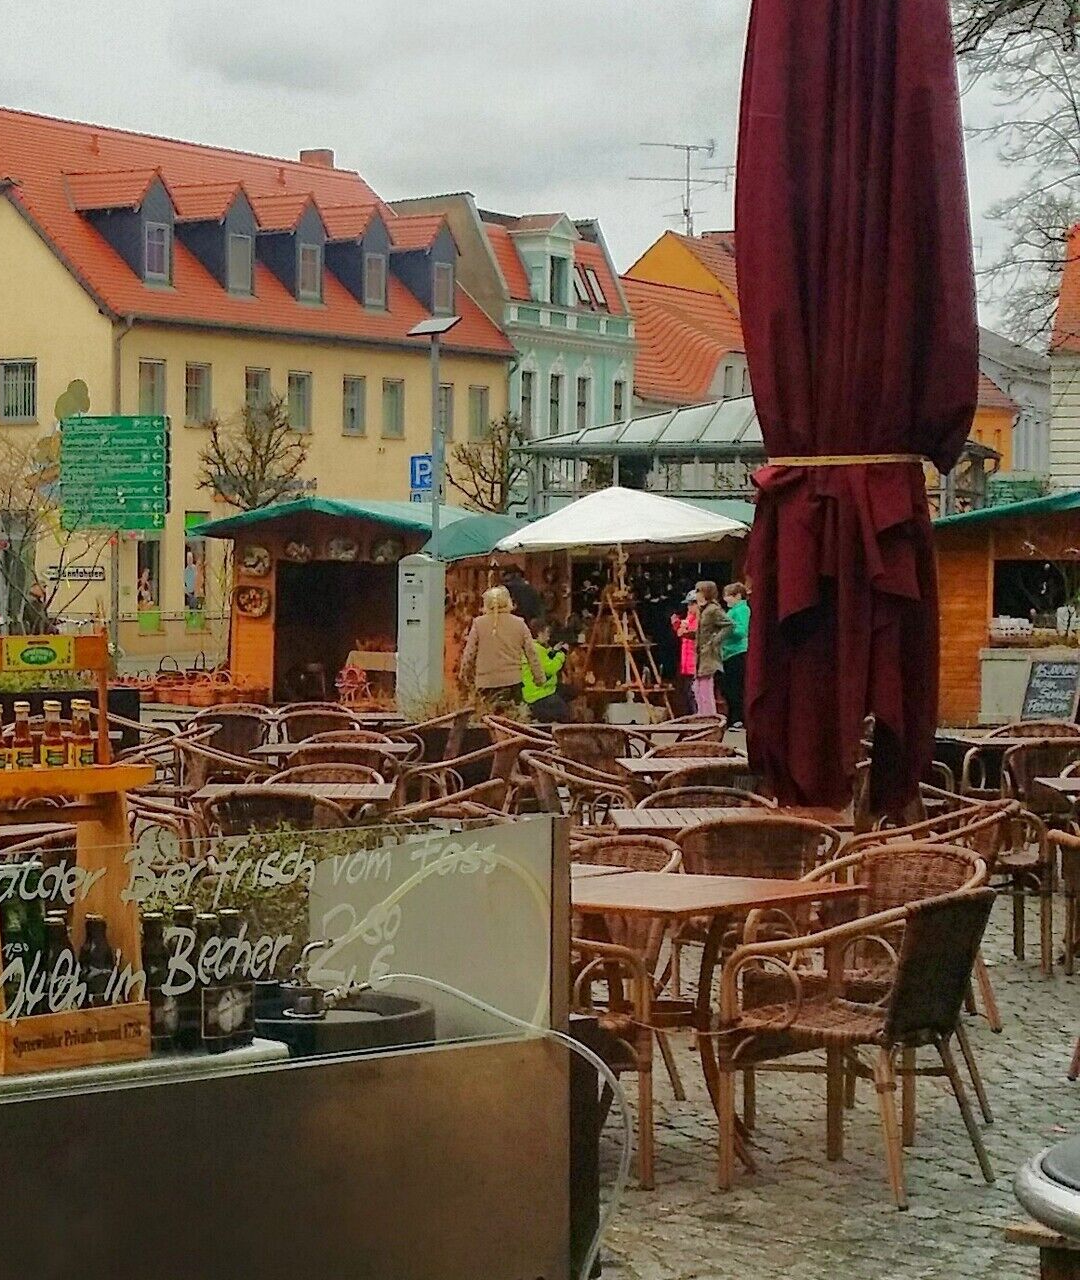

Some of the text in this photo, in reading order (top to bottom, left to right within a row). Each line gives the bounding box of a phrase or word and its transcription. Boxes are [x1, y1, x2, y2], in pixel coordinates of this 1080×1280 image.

[415, 460, 432, 485] P
[120, 837, 207, 904] Bier
[212, 841, 317, 909] frisch
[332, 851, 392, 886] vom
[105, 949, 147, 1005] im
[161, 922, 293, 996] Becher
